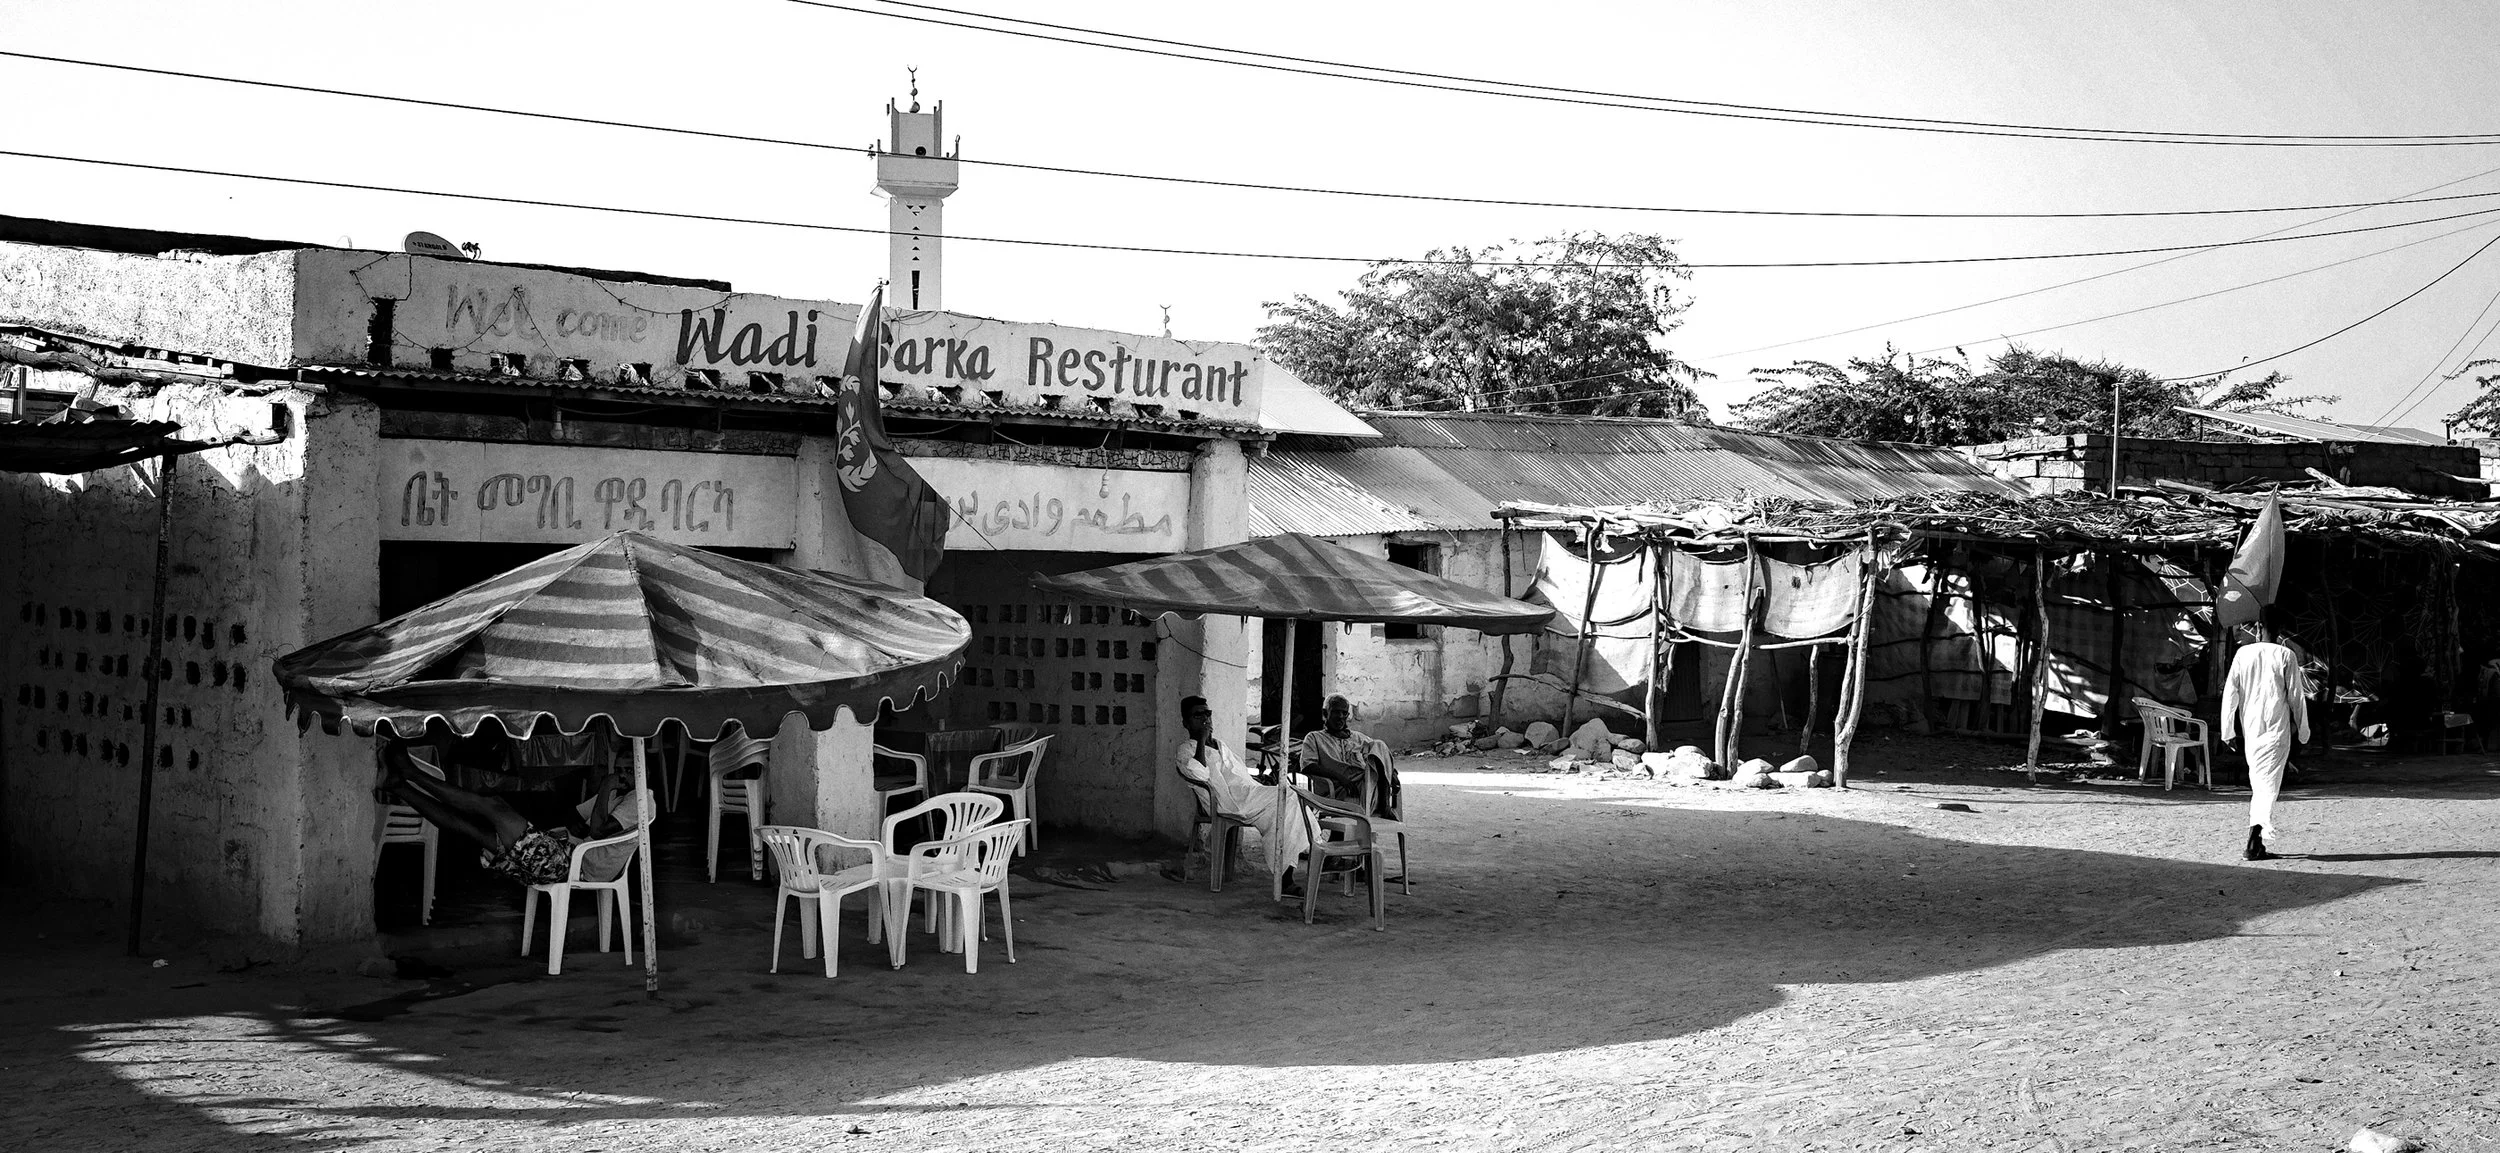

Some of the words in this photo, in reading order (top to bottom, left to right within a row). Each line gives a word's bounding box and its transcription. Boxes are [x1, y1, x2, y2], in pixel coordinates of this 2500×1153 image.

[555, 308, 649, 343] come
[676, 308, 818, 369] Wadi
[1027, 336, 1248, 407] Resturant
[401, 470, 458, 526] ቤት
[661, 479, 734, 532] ባርካ
[1071, 492, 1172, 543] مطعم
